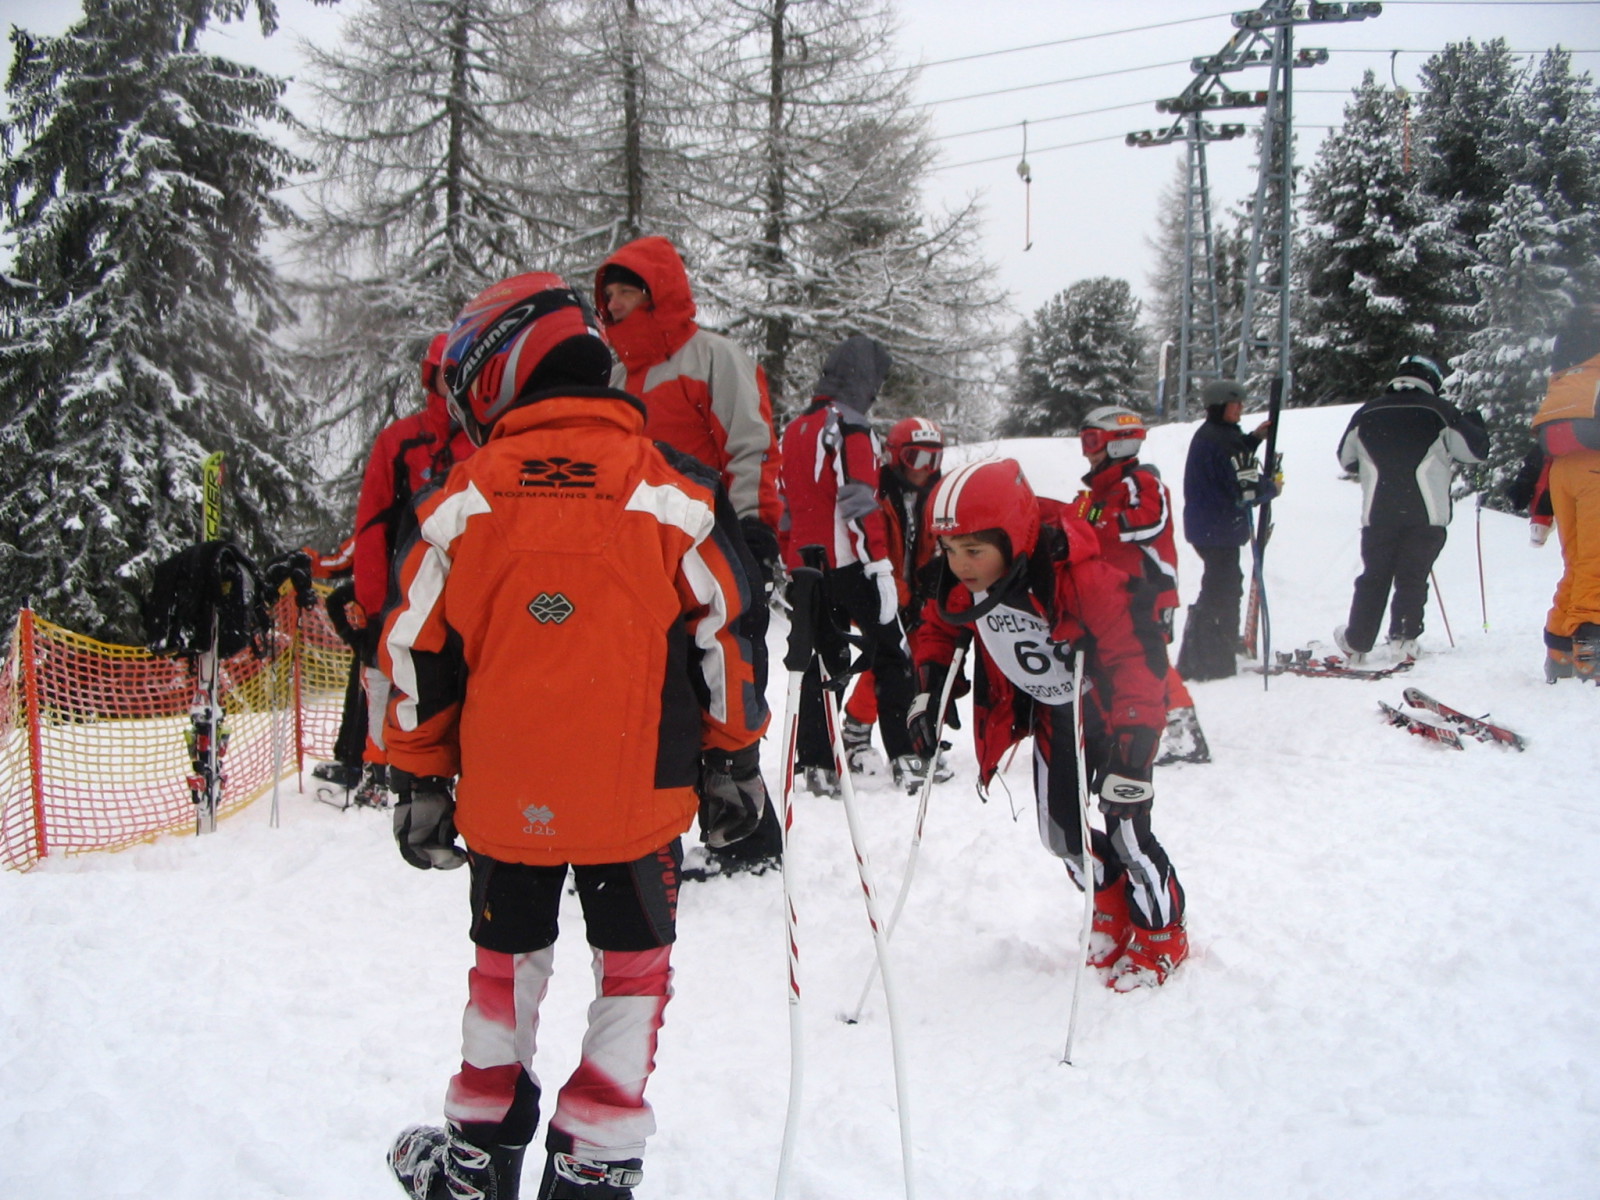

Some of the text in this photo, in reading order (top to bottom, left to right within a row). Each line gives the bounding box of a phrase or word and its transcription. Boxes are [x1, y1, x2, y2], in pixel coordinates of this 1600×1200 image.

[462, 318, 520, 383] ALPINA
[987, 614, 1026, 633] OPEL
[523, 825, 556, 836] d2b
